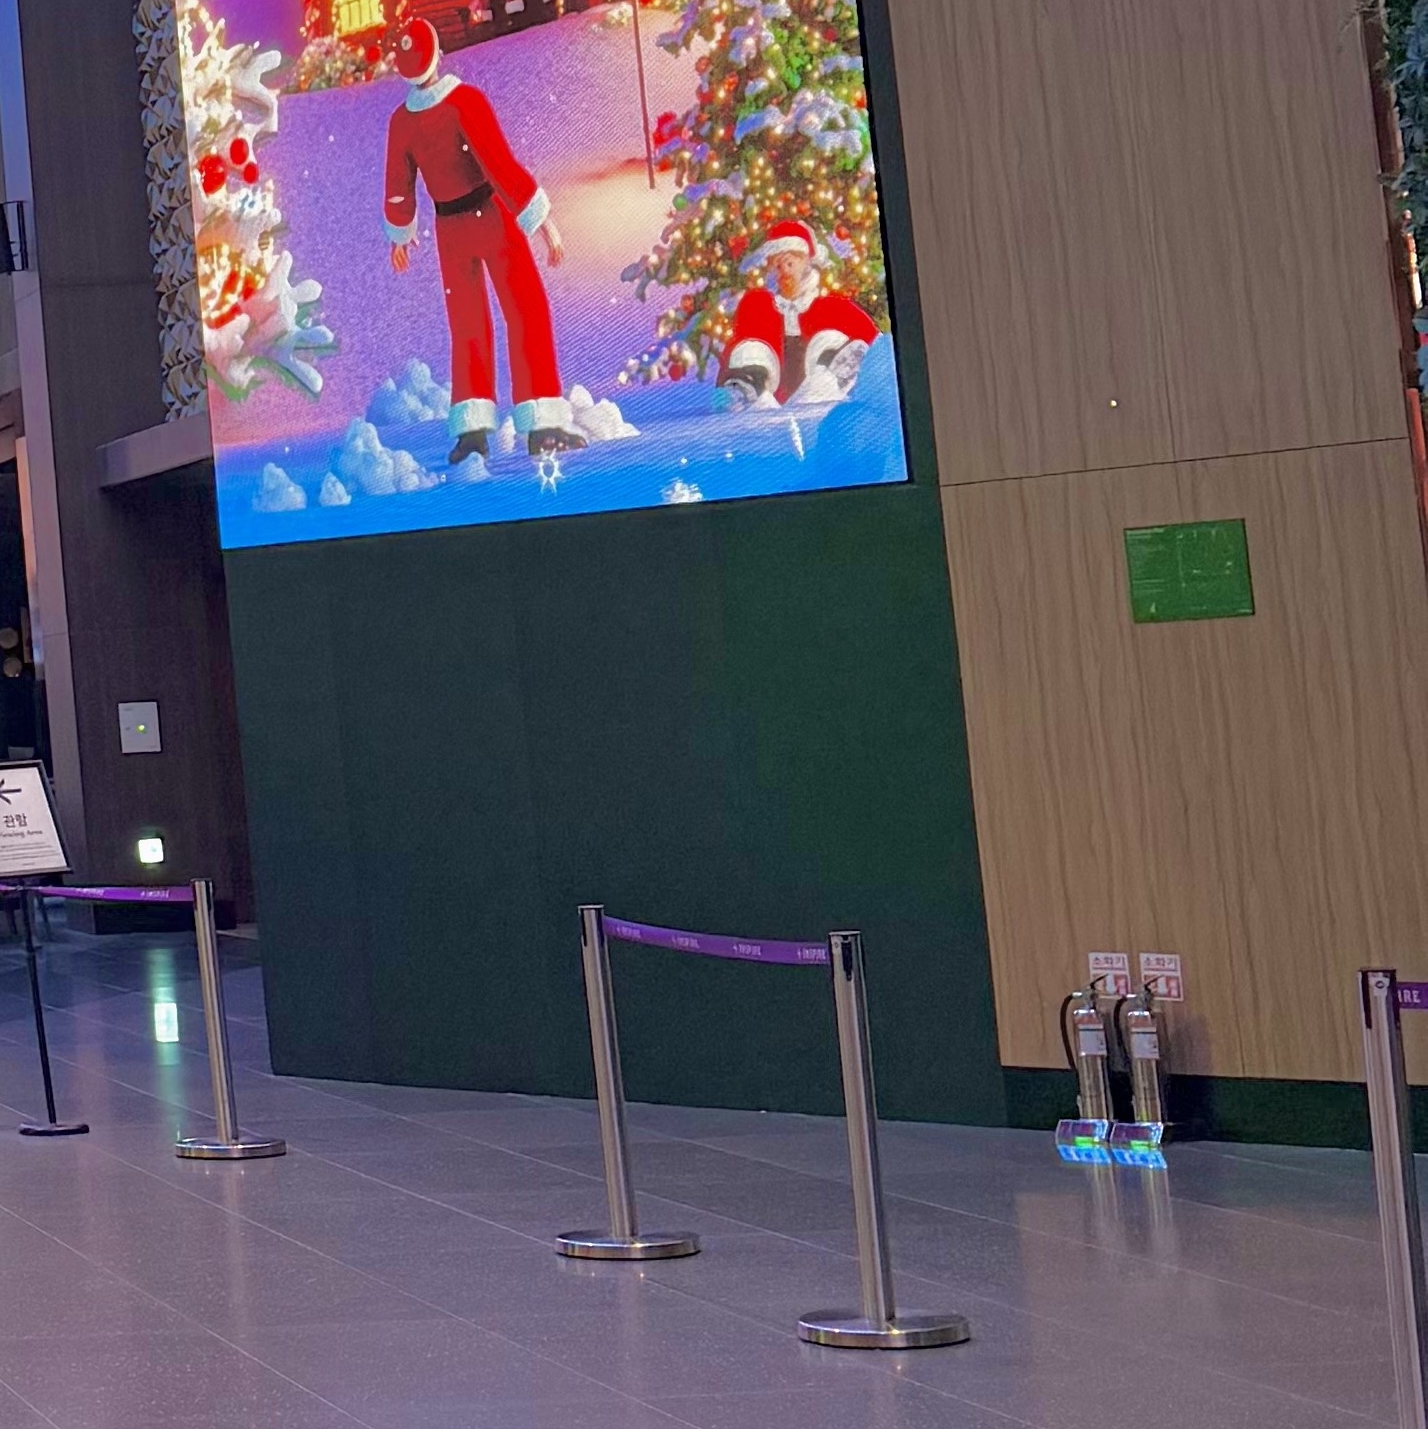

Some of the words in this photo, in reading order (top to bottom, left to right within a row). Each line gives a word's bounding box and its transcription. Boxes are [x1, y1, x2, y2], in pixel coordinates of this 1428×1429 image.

[3, 813, 28, 828] 관람
[1091, 954, 1127, 968] 소화기
[1143, 954, 1178, 968] 소화기
